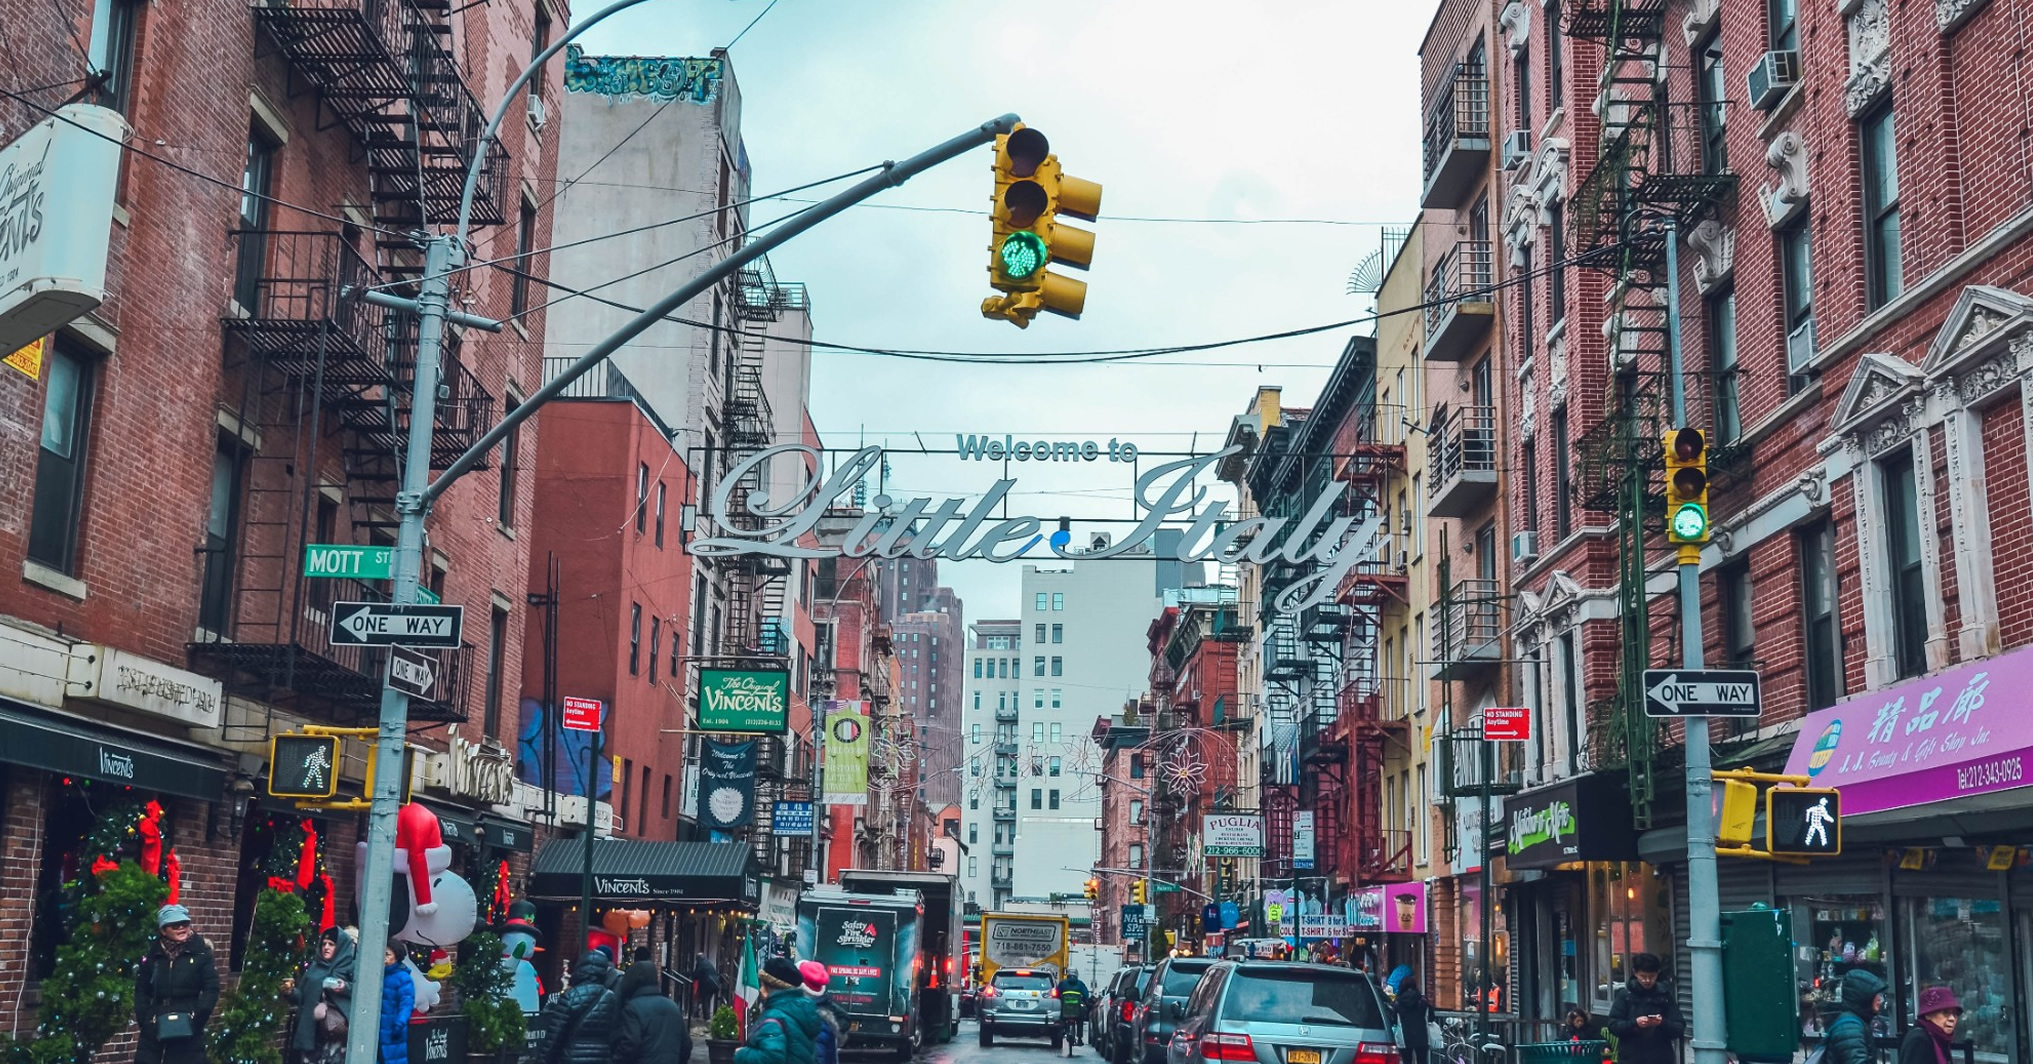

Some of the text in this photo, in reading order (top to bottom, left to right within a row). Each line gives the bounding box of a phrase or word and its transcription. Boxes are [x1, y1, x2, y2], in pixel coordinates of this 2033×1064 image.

[956, 433, 1139, 463] Welcome to
[694, 443, 1393, 614] Little Italy
[310, 550, 391, 574] MOTT ST
[353, 616, 445, 634] ONE WAY
[396, 659, 430, 683] ONE WAY
[722, 677, 780, 696] The Original
[1662, 684, 1750, 702] ONE WAY
[574, 701, 596, 711] STANDING
[704, 686, 783, 713] Vincent's
[1868, 672, 1990, 744] 精品廊
[1486, 710, 1524, 719] NO STANDING
[1486, 718, 1510, 726] Anytime
[1902, 742, 1913, 762] &
[1914, 737, 1938, 763] Gift
[1940, 730, 1967, 756] Shop
[1971, 726, 1991, 747] Inc.
[712, 749, 738, 760] Welcome
[722, 760, 735, 769] The
[1210, 816, 1260, 831] PUGLIA
[594, 876, 651, 895] Vincent's
[841, 920, 868, 932] Safety
[1281, 916, 1297, 925] WHIT
[1301, 916, 1325, 925] T-SHIRT
[1328, 916, 1333, 925] 8
[1301, 927, 1325, 936] T-SHIRT
[1328, 927, 1333, 936] 6
